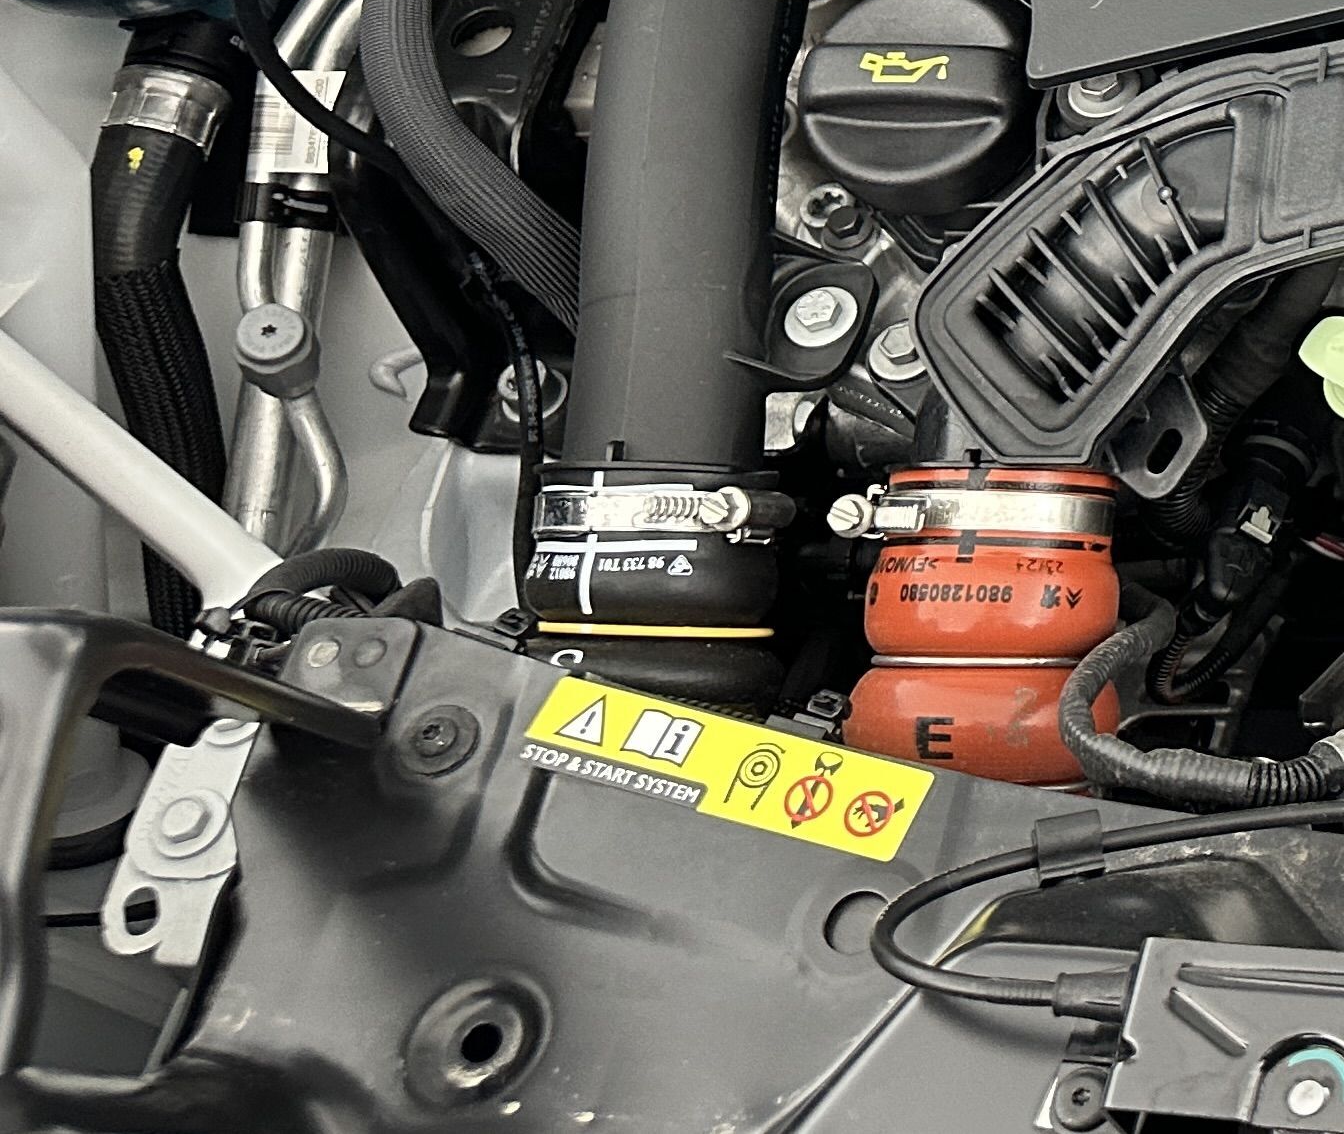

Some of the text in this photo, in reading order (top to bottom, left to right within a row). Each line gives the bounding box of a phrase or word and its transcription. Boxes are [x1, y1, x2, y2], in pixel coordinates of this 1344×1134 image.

[623, 556, 646, 571] 733
[647, 556, 665, 569] 98
[900, 583, 1013, 604] 9801280580
[916, 716, 954, 760] E
[520, 744, 701, 804] STOP & START SYSTEM
